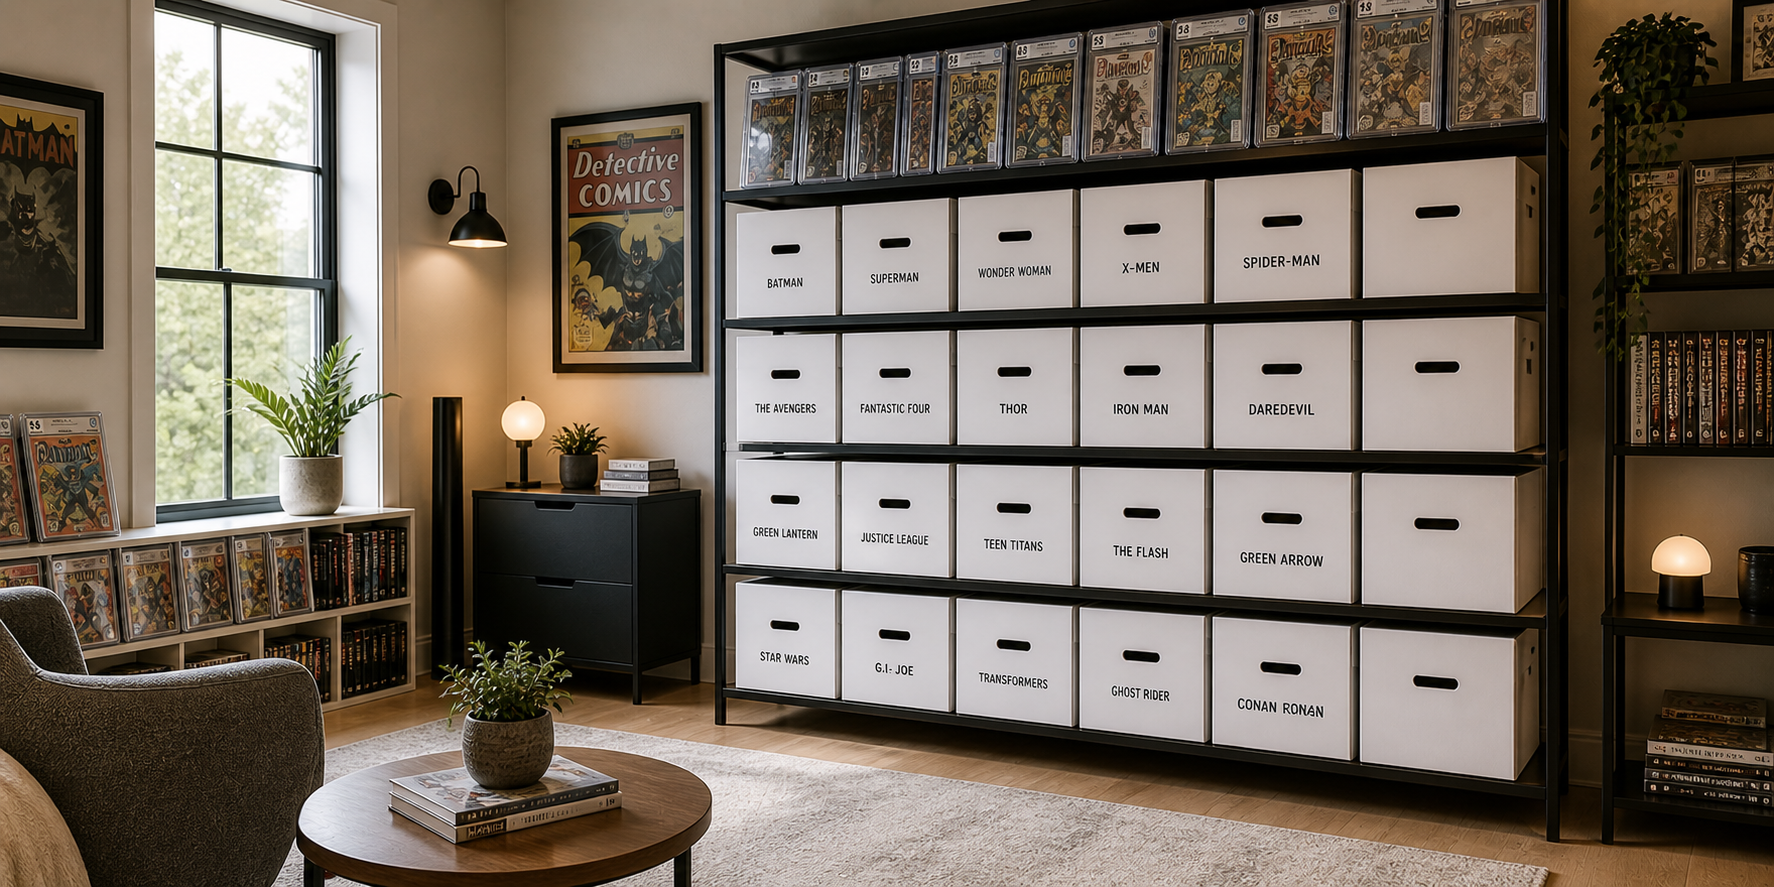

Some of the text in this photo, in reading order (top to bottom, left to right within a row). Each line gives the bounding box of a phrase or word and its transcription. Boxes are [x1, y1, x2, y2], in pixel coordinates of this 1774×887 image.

[0, 128, 74, 168] ATMAN
[573, 147, 679, 179] Detective
[577, 178, 673, 208] COMICS
[1122, 261, 1160, 275] X-MEN
[1243, 253, 1320, 270] SPIDER-MAN
[870, 271, 919, 285] SUPERMAN
[977, 265, 1052, 279] WONDER WOMAN
[767, 277, 804, 289] BATMAN
[754, 403, 817, 414] THE AVENGERS
[860, 402, 931, 414] FANTASTIC FOUR
[999, 403, 1028, 415] THOR
[1113, 403, 1169, 416] IRON MAN
[1248, 403, 1315, 416] DAREDEVIL
[752, 526, 819, 540] GREEN LANTERN
[860, 532, 929, 546] JUSTICE LEAGUE
[983, 538, 1044, 552] TEEN TITANS
[1112, 544, 1169, 559] THE FLASH
[1239, 551, 1324, 568] GREEN ARROW
[759, 650, 810, 666] STAR WARS
[894, 664, 914, 677] JOE
[978, 671, 1049, 690] TRANSFORMERS
[1111, 685, 1170, 702] GHOST RIDER
[1237, 697, 1277, 714] CONAN
